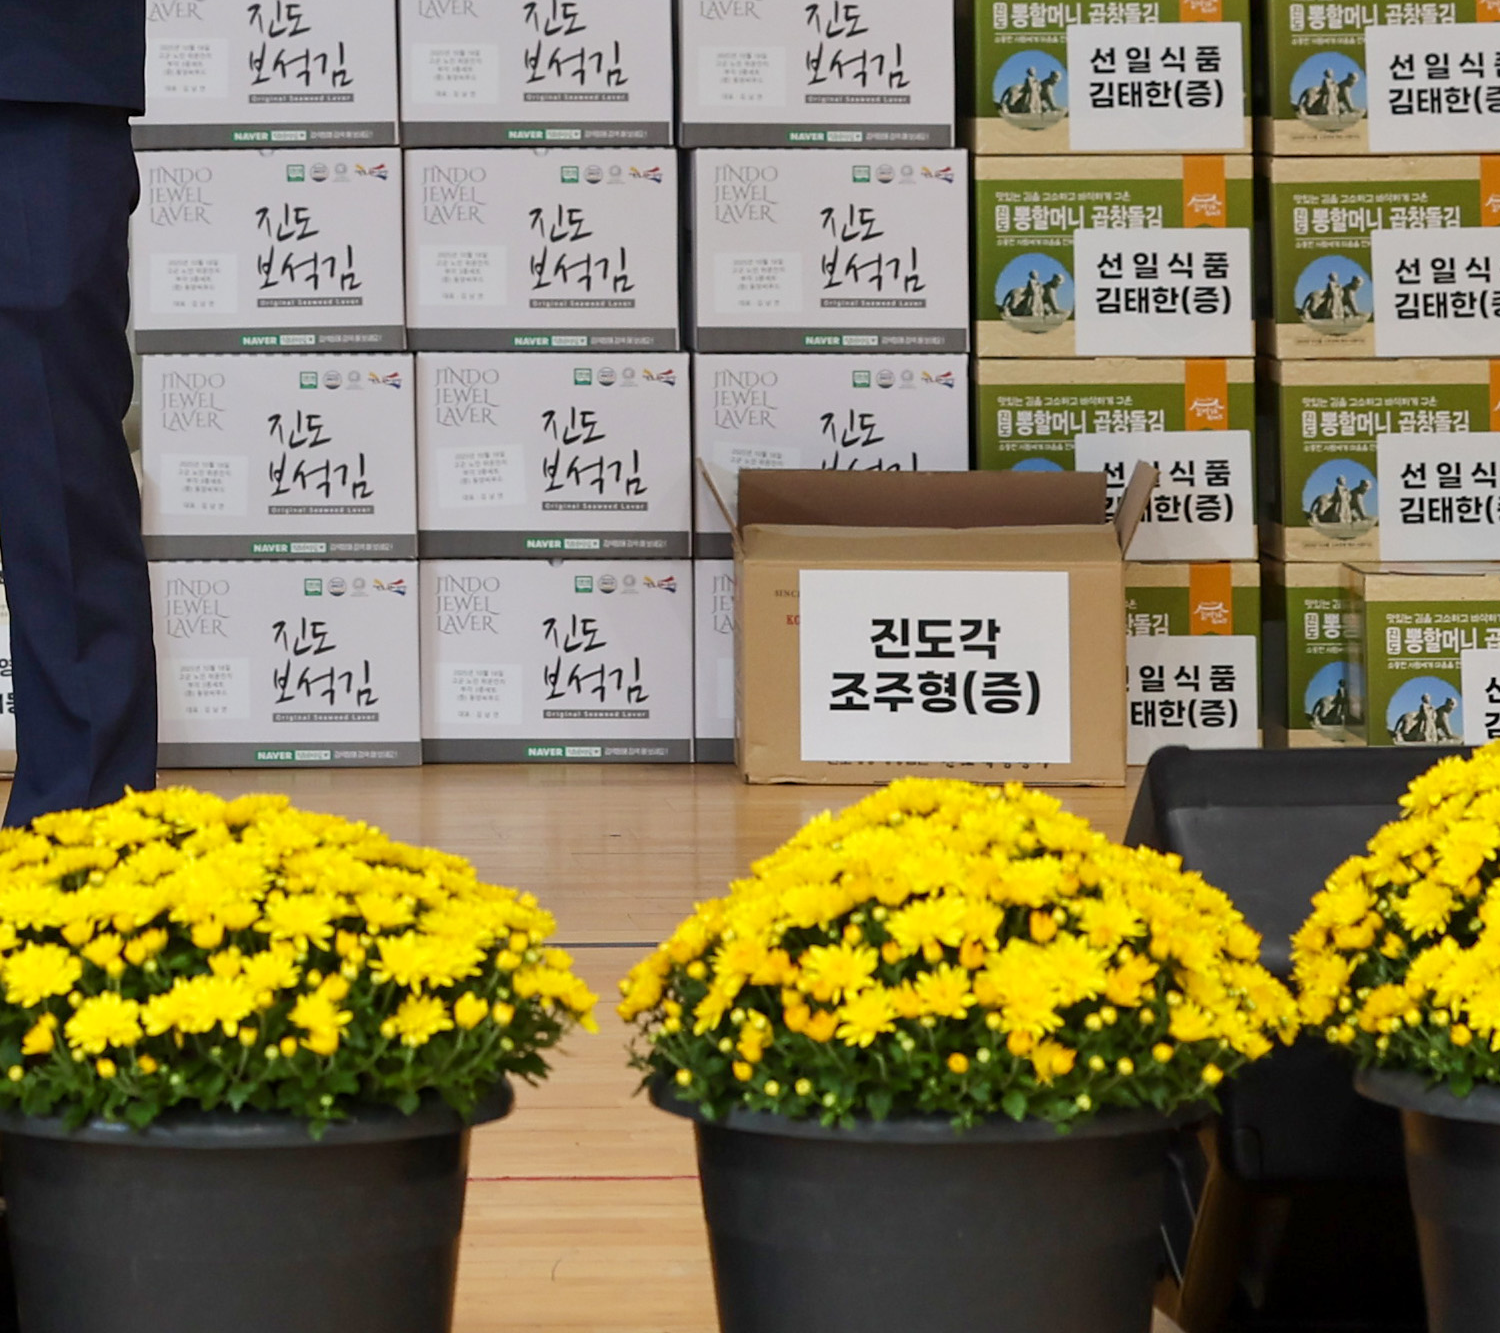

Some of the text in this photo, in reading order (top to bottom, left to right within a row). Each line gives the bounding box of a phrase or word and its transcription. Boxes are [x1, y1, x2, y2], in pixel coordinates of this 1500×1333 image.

[248, 0, 311, 38] 진도
[418, 0, 481, 18] LAVER
[805, 0, 868, 39] 진도
[249, 42, 353, 87] 보석김
[525, 40, 628, 87] 보석김
[806, 42, 910, 88] 보석김
[1090, 79, 1223, 108] 김태한(증)
[509, 130, 540, 140] NAVER
[256, 203, 319, 242] 진도
[529, 204, 592, 243] 진도
[820, 204, 884, 242] 진도
[258, 245, 361, 291] 보석김
[530, 246, 634, 293] 보석김
[822, 246, 925, 293] 보석김
[1097, 286, 1231, 314] 김태한(증)
[161, 372, 226, 392] JINDO
[161, 393, 226, 412] JEWEL
[162, 412, 225, 431] LAVER
[268, 410, 331, 449] 진도
[542, 407, 605, 445] 진도
[820, 409, 884, 447] 진도
[269, 453, 373, 499] 보석김
[543, 448, 647, 495] 보석김
[1103, 495, 1234, 522] 한(증)
[253, 543, 288, 553] NAVER
[436, 575, 500, 595] JINDO
[774, 589, 800, 598] SINC
[436, 596, 500, 615] JEWEL
[272, 617, 336, 656] 진도
[436, 616, 500, 634] LAVER
[543, 614, 606, 653] 진도
[871, 618, 1000, 659] 진도각
[274, 659, 378, 706] 보석김
[544, 656, 649, 703] 보석김
[830, 671, 1040, 715] 조주형(증)
[1130, 700, 1238, 728] 태한(증)
[528, 747, 562, 756] NAVER
